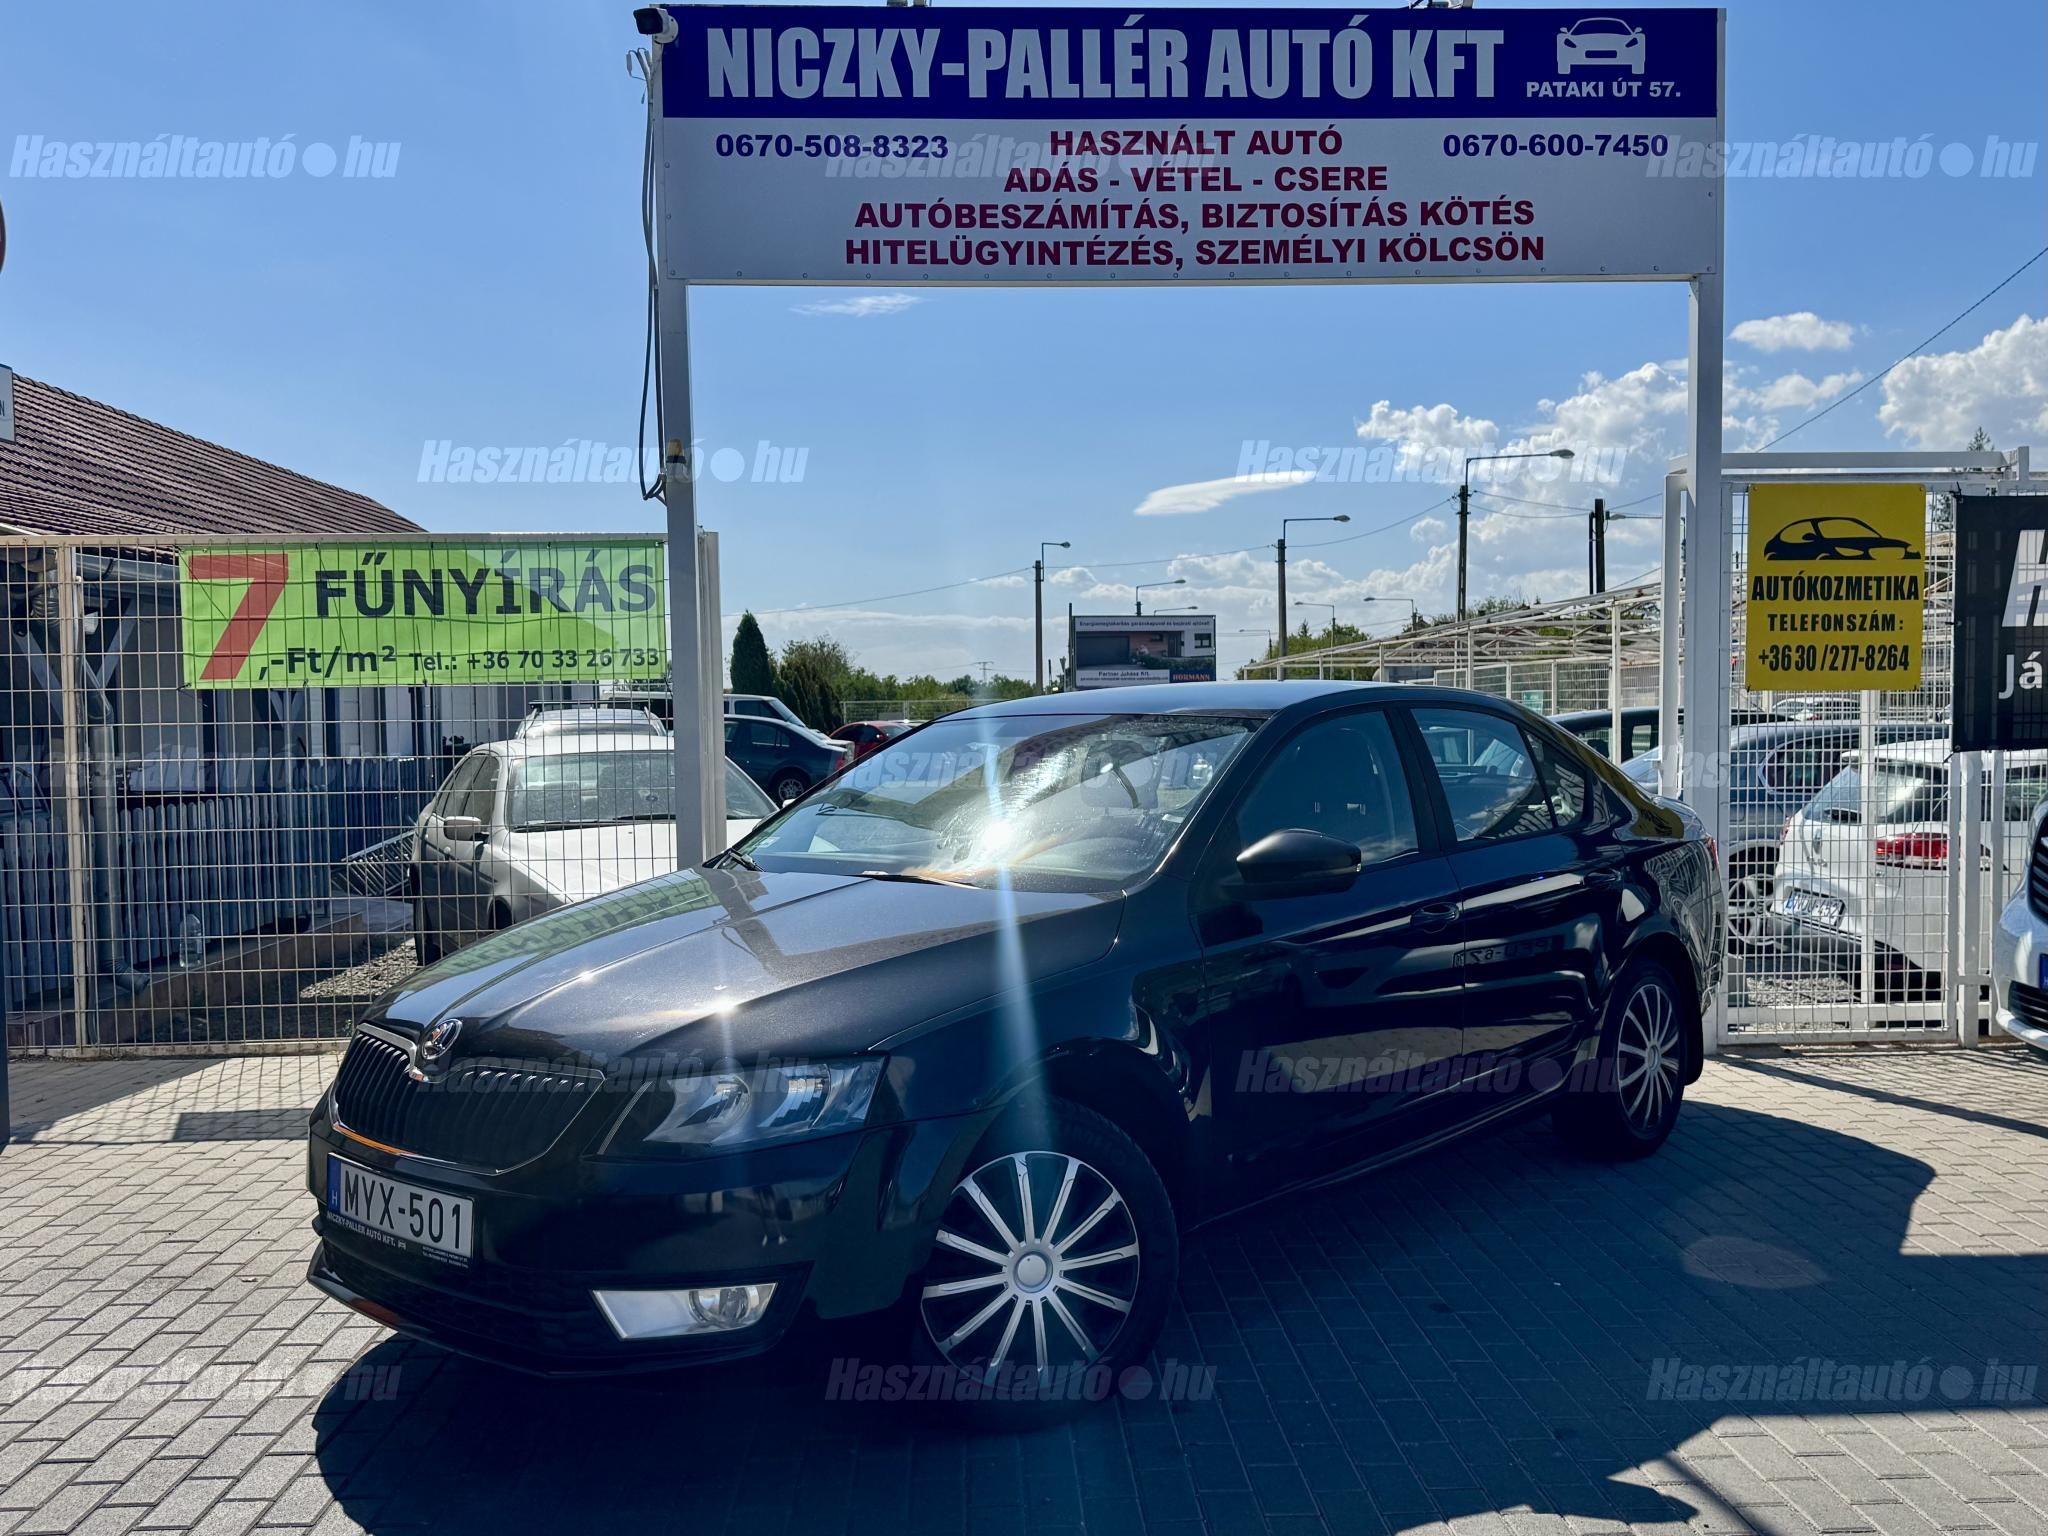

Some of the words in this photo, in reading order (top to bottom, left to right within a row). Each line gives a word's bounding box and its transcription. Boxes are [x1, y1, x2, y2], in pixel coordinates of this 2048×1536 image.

[707, 15, 1189, 99] NICZKY-PALLÉR
[1204, 15, 1373, 99] AUTÓ
[1392, 29, 1504, 98] KFT
[1526, 82, 1604, 98] PATAKI
[1612, 78, 1642, 98] ÚT
[1648, 81, 1682, 98] 57.
[715, 134, 949, 159] 0670-508-8323
[1050, 123, 1236, 156] HASZNÁLT
[1246, 123, 1343, 156] AUTÓ
[1443, 134, 1669, 158] 0670-600-7450
[1003, 160, 1099, 193] ADÁS
[1131, 160, 1242, 193] VÉTEL
[1274, 166, 1388, 193] CSERE
[855, 197, 1189, 235] AUTÓBESZÁMÍTÁS,
[1201, 196, 1408, 230] BIZTOSÍTÁS
[1420, 195, 1536, 227] KÖTÉS
[846, 232, 1184, 272] HITELÜGYINTÉZÉS,
[1195, 232, 1366, 267] SZEMÉLYI
[1378, 232, 1545, 263] KÖLCSÖN
[314, 551, 656, 618] FŰNYÍRÁS
[1752, 570, 1920, 602] AUTÓKOZMETIKA
[1768, 610, 1904, 632] TELEFONSZÁM:
[408, 652, 457, 672] Tel.:
[467, 649, 510, 670] +36
[517, 650, 544, 669] 70
[551, 648, 578, 669] 33
[586, 648, 612, 668] 26
[620, 647, 659, 667] 733
[344, 1170, 461, 1249] MYX-501
